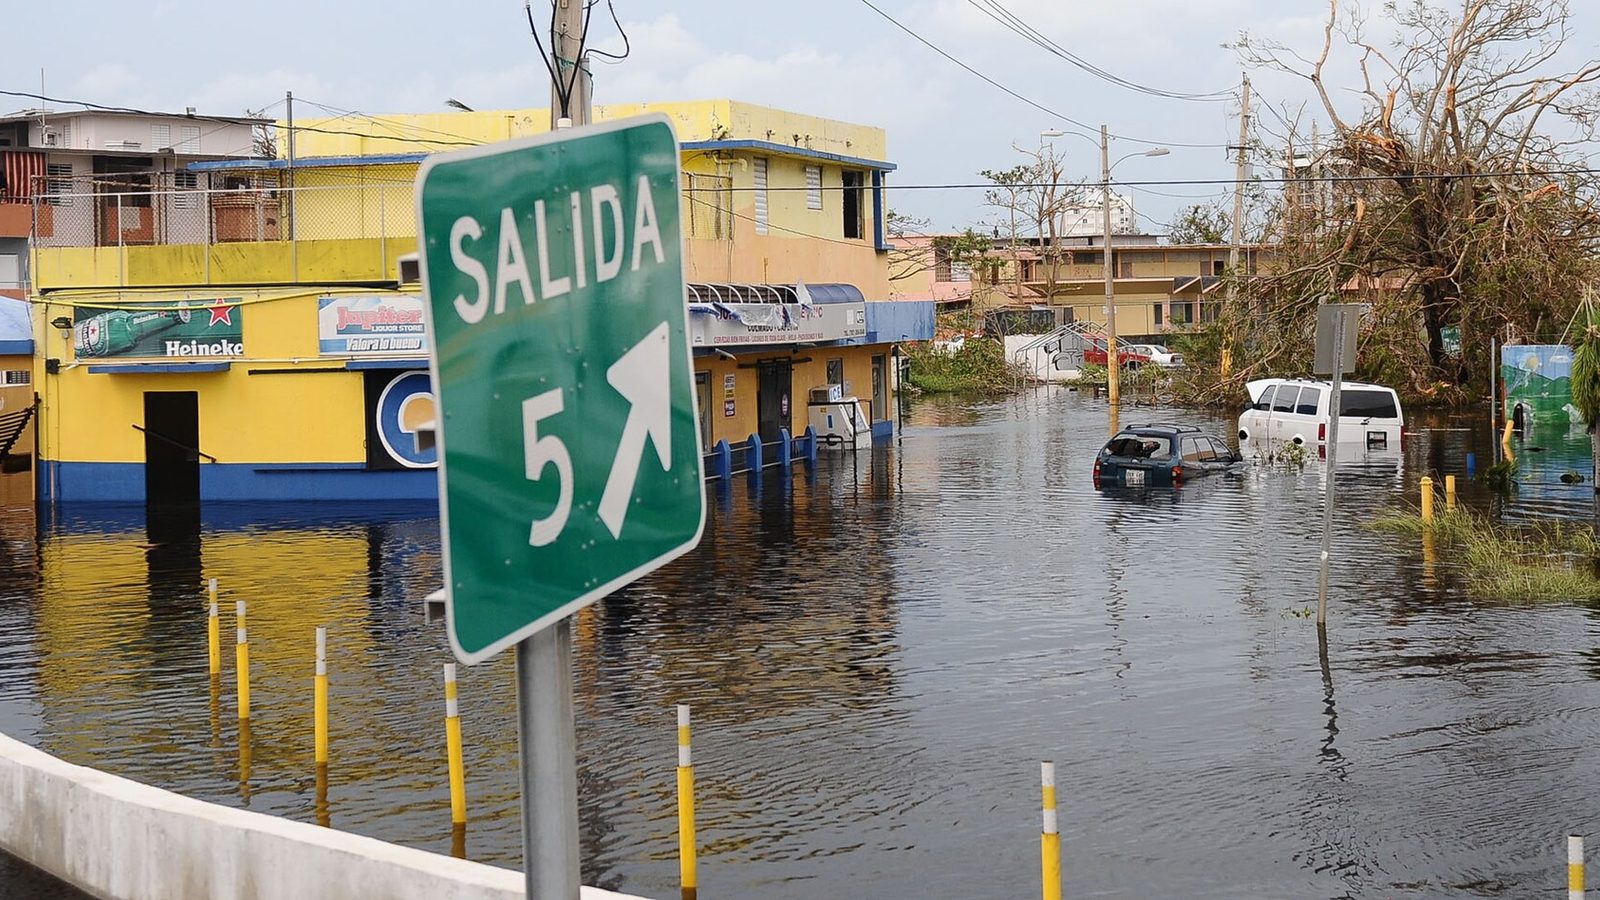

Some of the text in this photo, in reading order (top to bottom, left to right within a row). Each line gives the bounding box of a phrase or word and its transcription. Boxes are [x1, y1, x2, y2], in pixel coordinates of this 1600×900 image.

[449, 174, 664, 325] SALIDA
[337, 306, 422, 331] Jupiter
[399, 324, 424, 332] STORE
[346, 338, 421, 351] Valora lo bueno
[830, 386, 841, 401] ICE
[521, 387, 574, 547] 5
